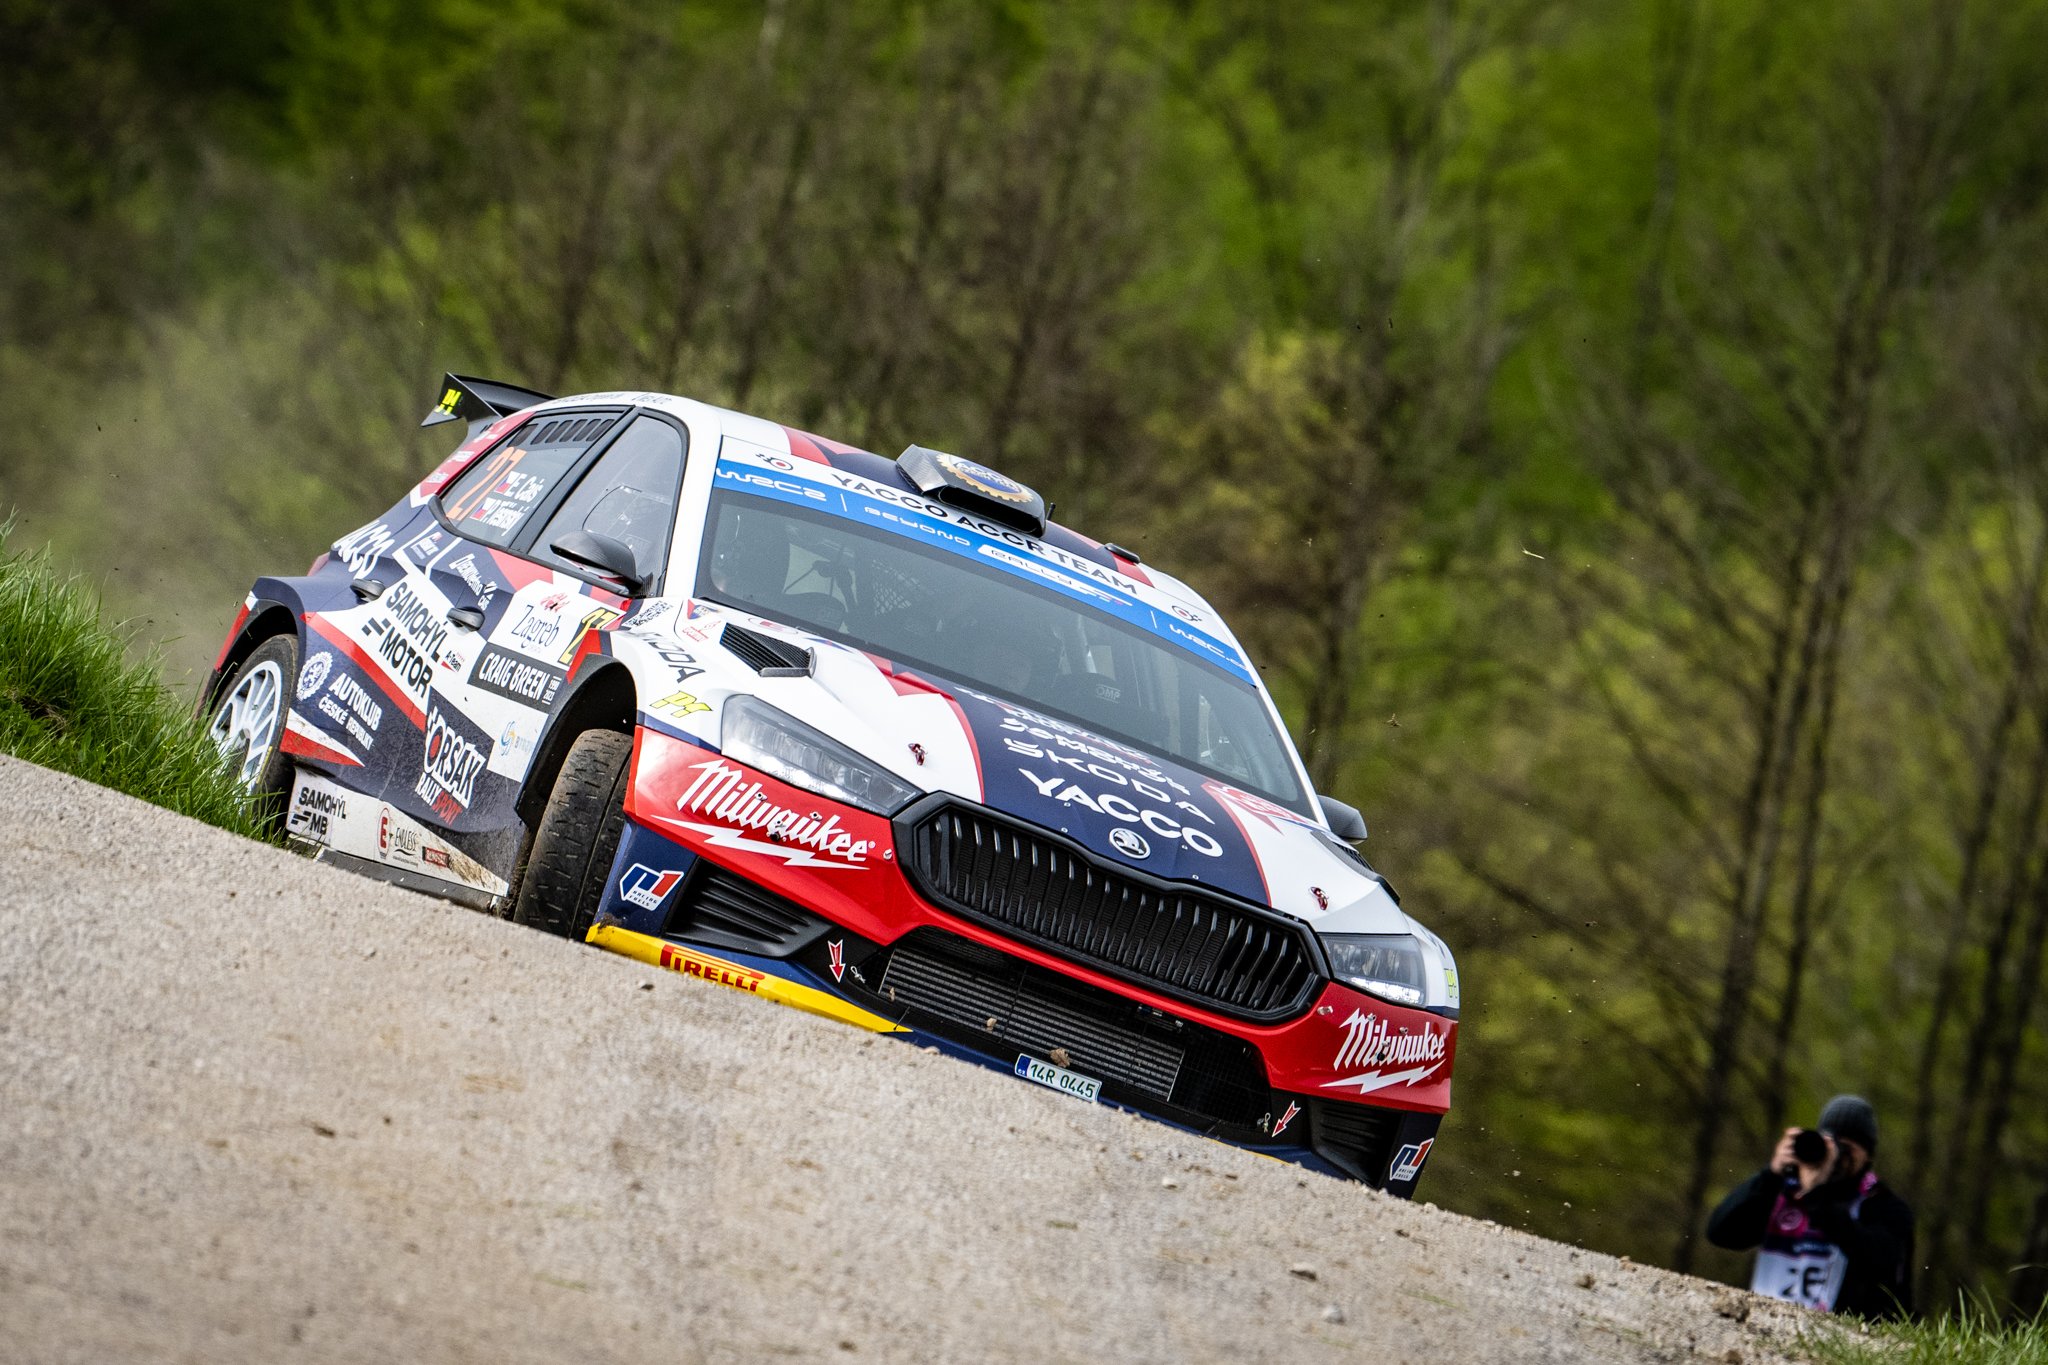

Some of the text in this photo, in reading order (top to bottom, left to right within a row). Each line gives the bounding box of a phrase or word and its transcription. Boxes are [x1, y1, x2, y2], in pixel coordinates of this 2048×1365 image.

[716, 468, 827, 501] WRC2
[864, 506, 971, 546] BEYOND
[832, 474, 948, 517] YACCO
[957, 516, 1047, 555] ACCR
[1051, 550, 1138, 595] TEAM
[511, 604, 561, 649] Zagreb
[379, 626, 433, 698] MOTOR
[478, 653, 551, 701] CRAIG BREEN
[318, 693, 349, 725] ČESKÉ
[328, 672, 382, 731] AUTOKLUB
[310, 813, 328, 835] MB
[676, 759, 868, 862] Milwaukee
[1019, 768, 1223, 858] YACCO
[660, 944, 765, 992] PIRELLI
[1333, 1007, 1446, 1072] Milwaukee
[1030, 1063, 1096, 1099] 14R 0445
